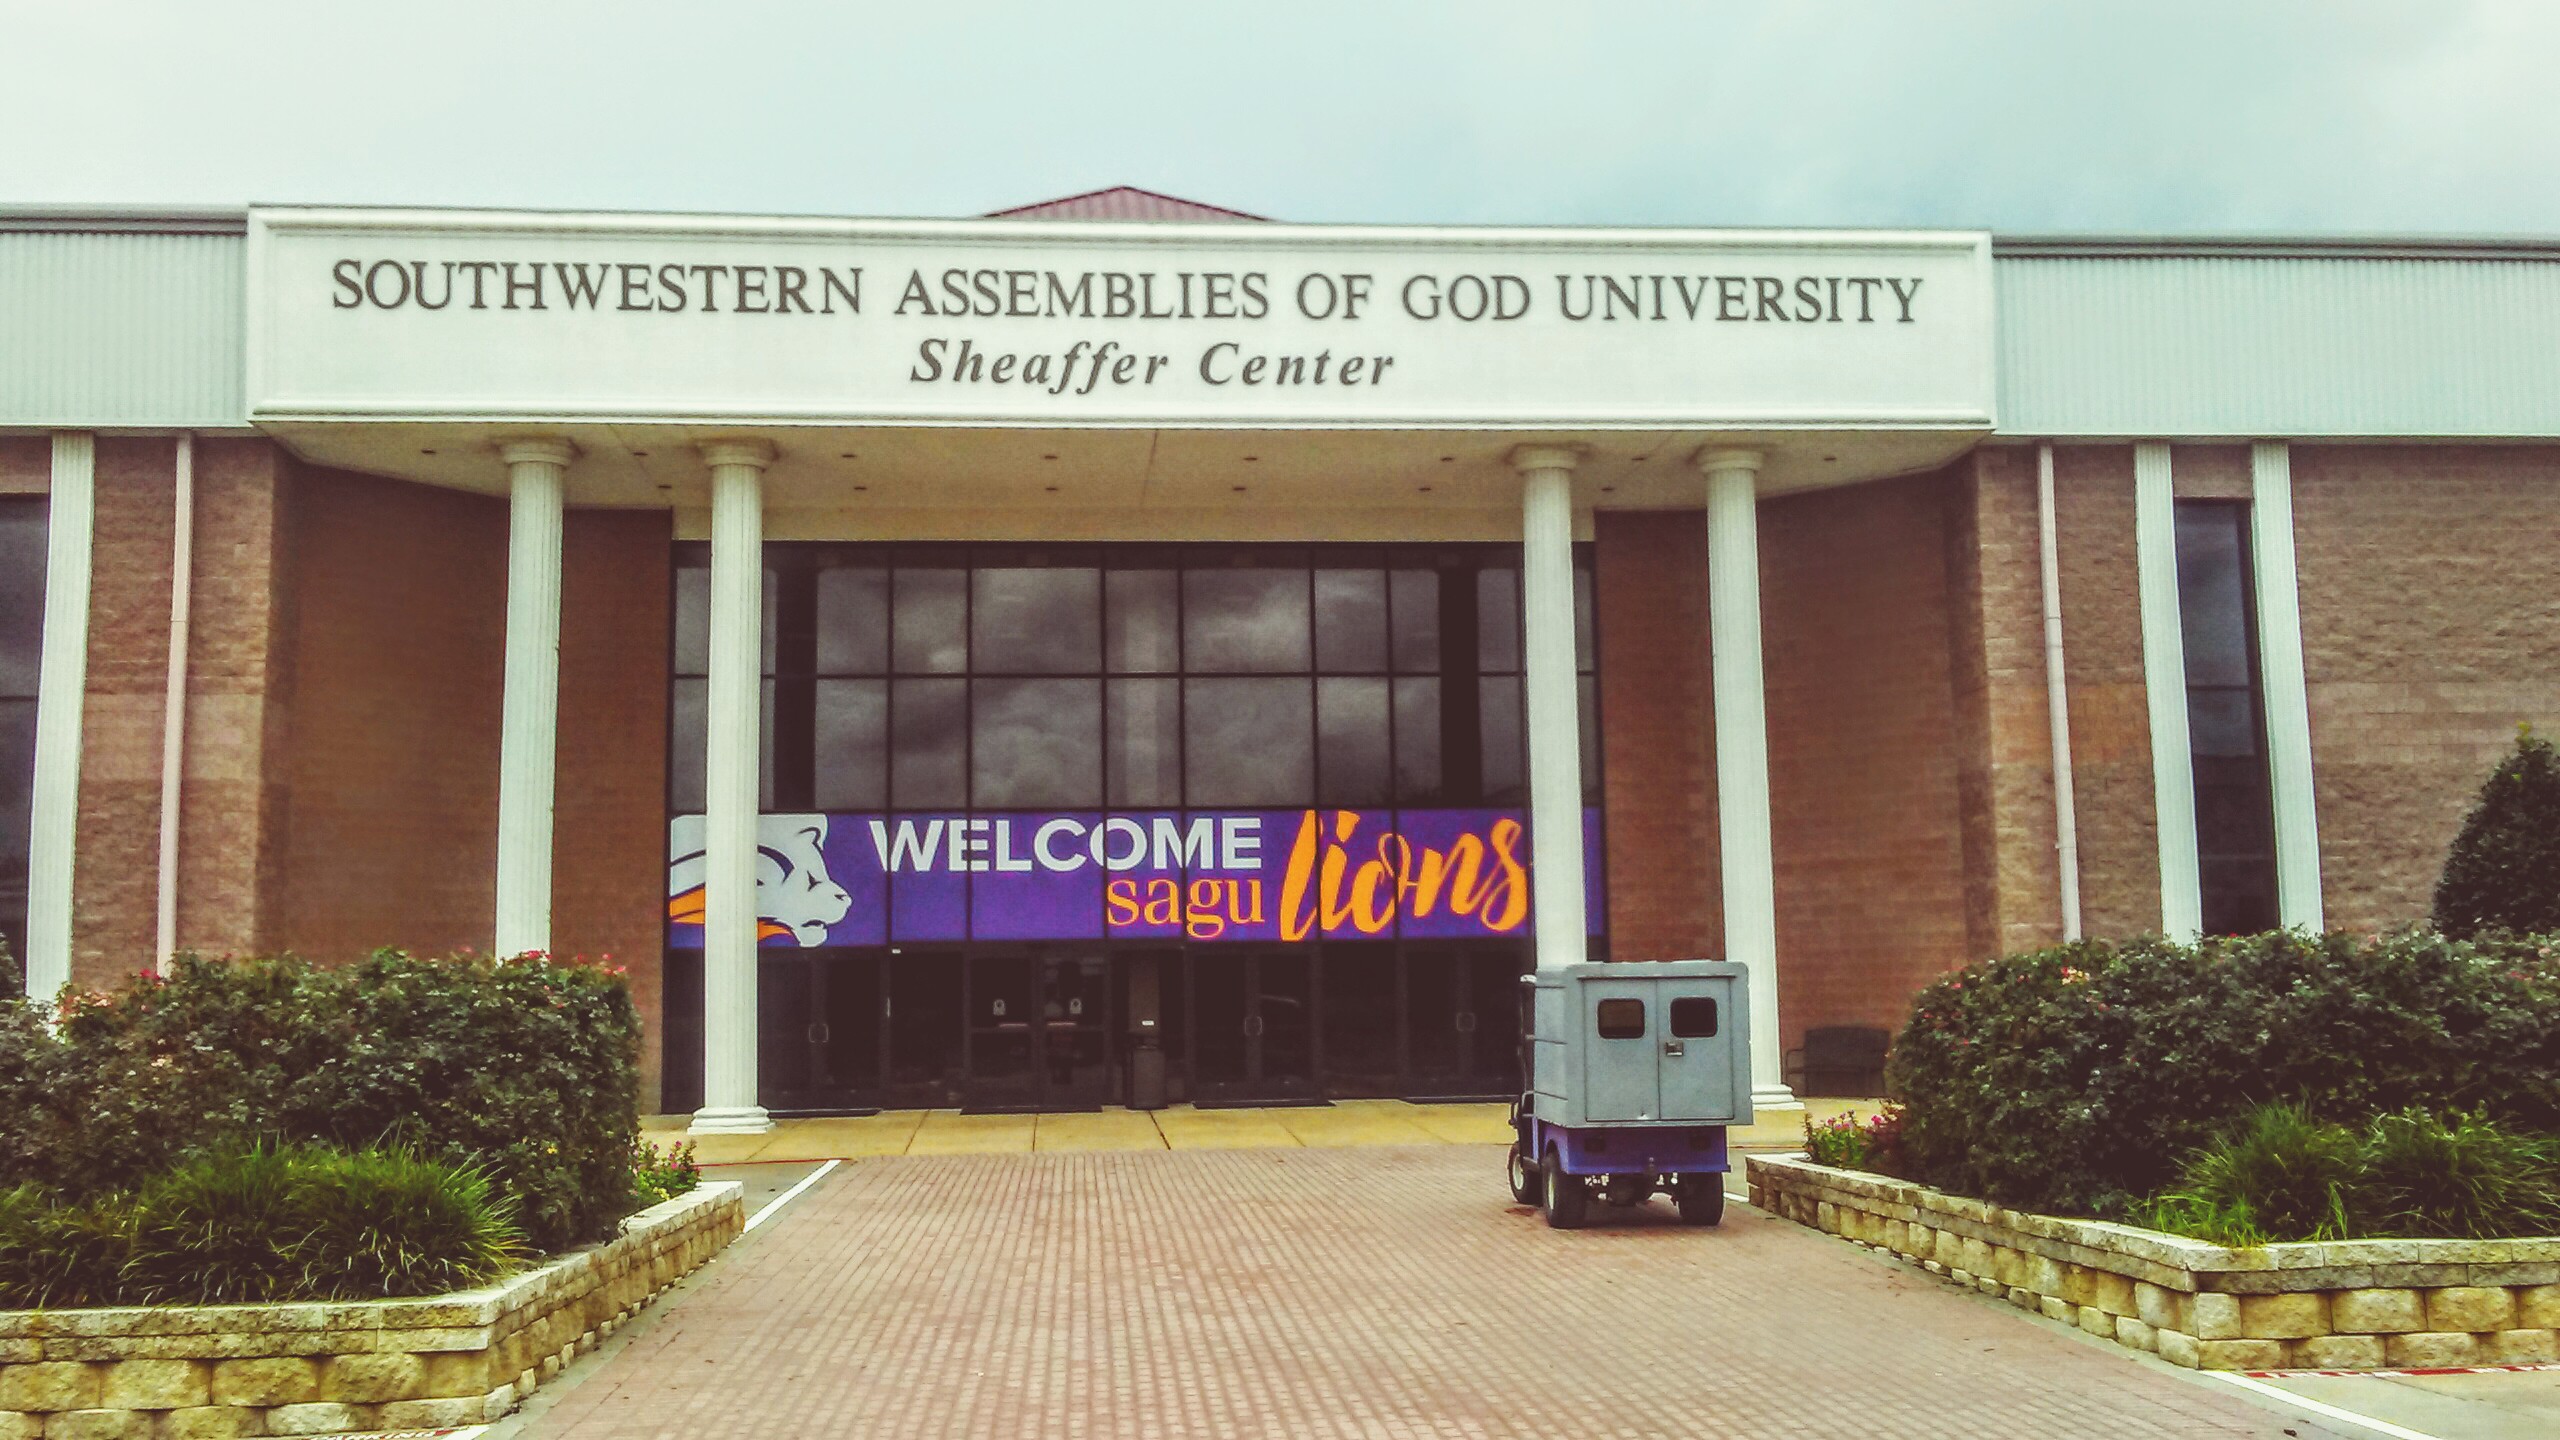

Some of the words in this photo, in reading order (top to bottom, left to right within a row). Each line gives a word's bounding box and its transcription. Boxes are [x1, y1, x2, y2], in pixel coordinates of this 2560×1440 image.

[333, 259, 863, 314] SOUTHWESTERN
[894, 269, 1268, 319] ASSEMBLIES
[1297, 273, 1372, 320] OF
[1402, 275, 1530, 321] GOD
[1556, 275, 1923, 323] UNIVERSITY
[910, 339, 1168, 394] Sheaffer
[1200, 343, 1393, 385] Center
[869, 818, 1263, 872] WELCOME
[1107, 878, 1265, 938] sagu
[1280, 809, 1528, 942] lions
